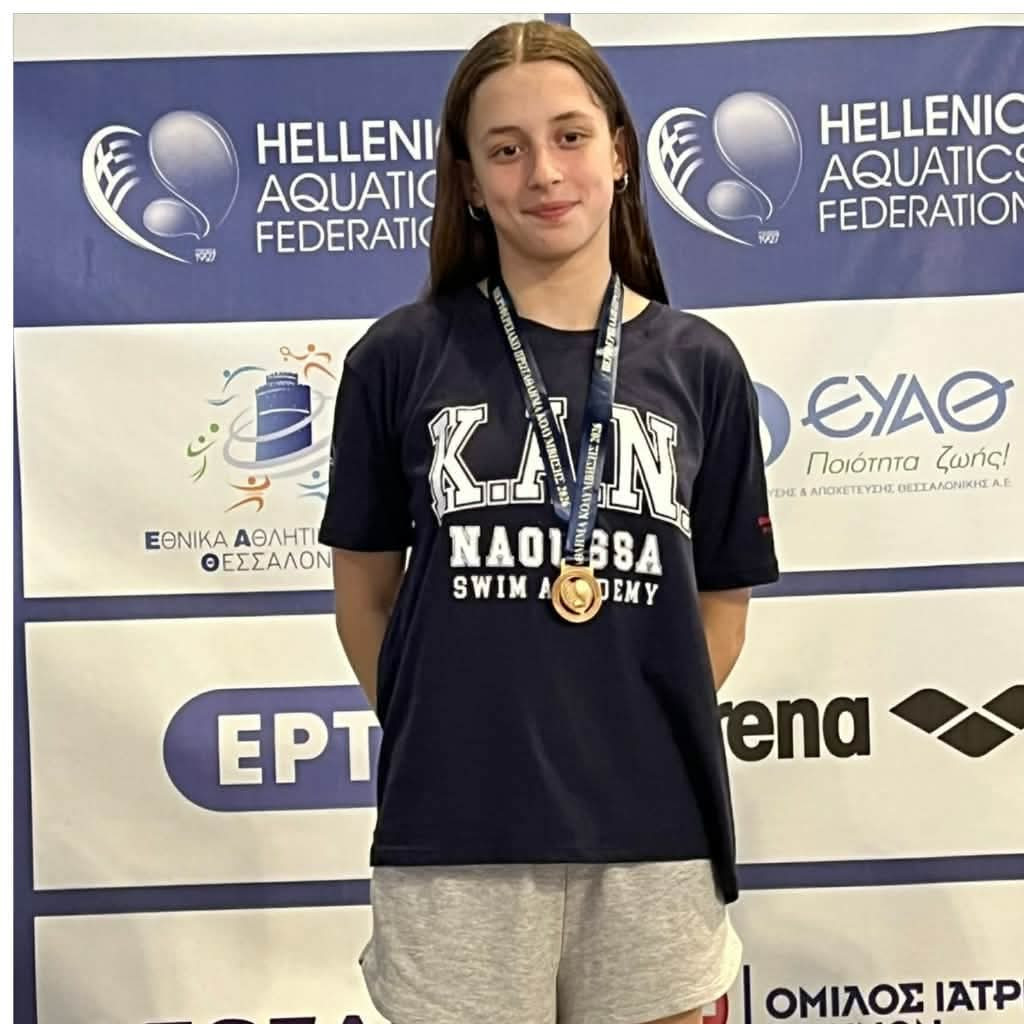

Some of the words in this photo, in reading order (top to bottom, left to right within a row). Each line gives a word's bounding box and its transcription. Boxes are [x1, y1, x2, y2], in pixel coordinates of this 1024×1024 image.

[806, 451, 919, 475] Ποιότητα
[936, 443, 1011, 474] ζωής!
[144, 530, 228, 550] ΕΘΝΙΚΑ
[453, 575, 527, 599] SWIM
[217, 710, 381, 786] ΕΡΤ
[766, 983, 924, 1019] ΟΜΙΛΟΣ
